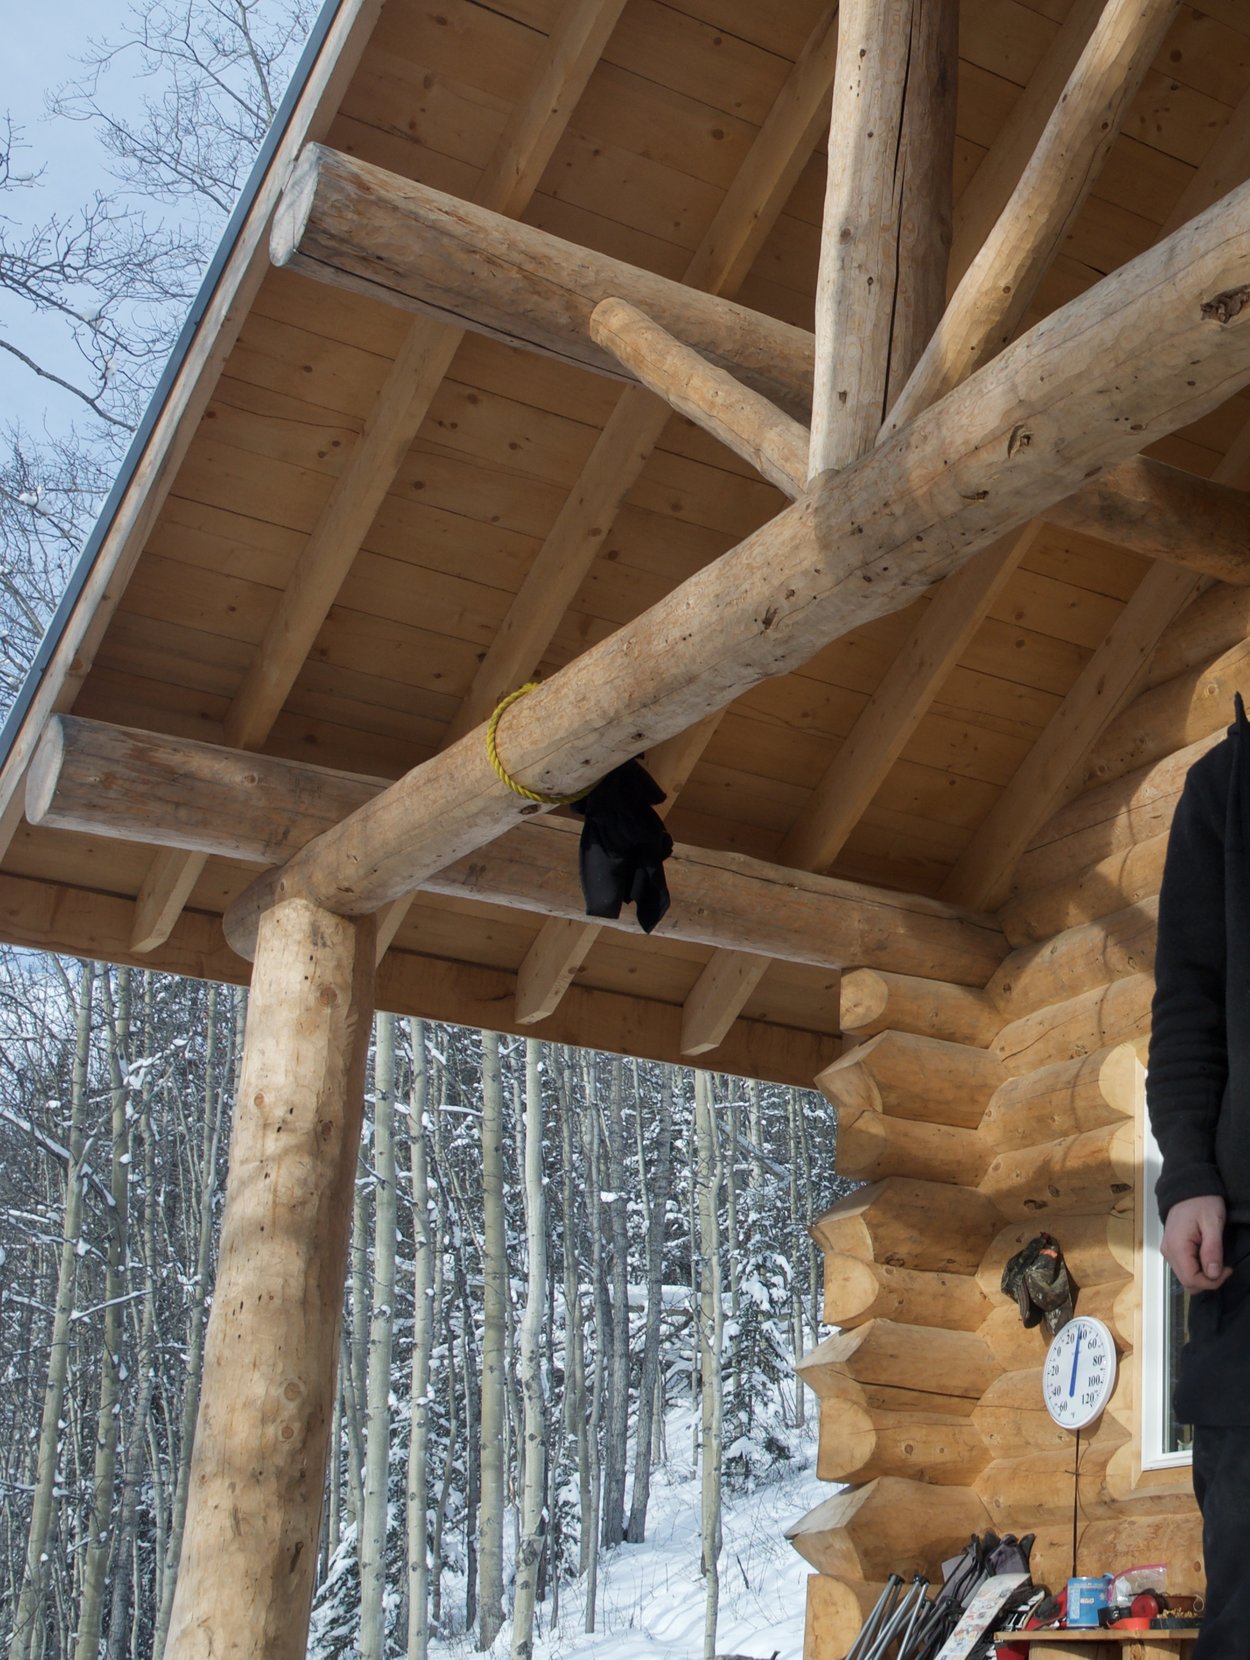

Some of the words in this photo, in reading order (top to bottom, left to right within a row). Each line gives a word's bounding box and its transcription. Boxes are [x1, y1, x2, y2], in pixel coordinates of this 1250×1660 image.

[1066, 1333, 1075, 1344] 20
[1087, 1338, 1097, 1350] 60
[1056, 1346, 1062, 1357] 0
[1092, 1354, 1103, 1367] 80
[1088, 1374, 1101, 1387] 100
[1081, 1393, 1095, 1405] 120
